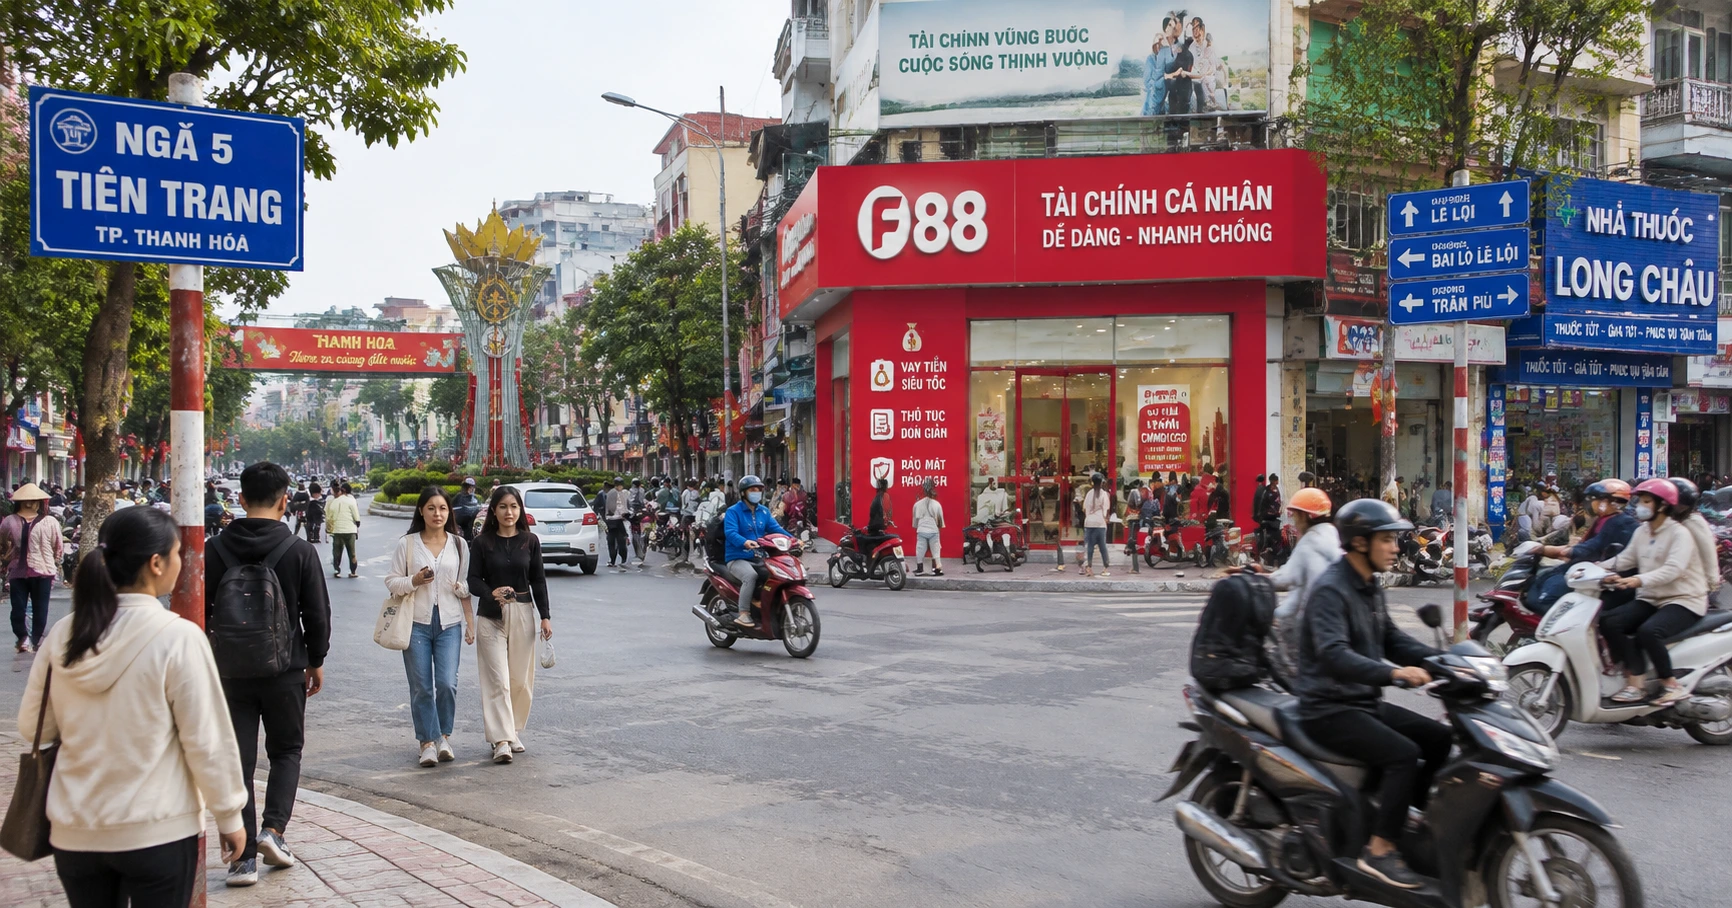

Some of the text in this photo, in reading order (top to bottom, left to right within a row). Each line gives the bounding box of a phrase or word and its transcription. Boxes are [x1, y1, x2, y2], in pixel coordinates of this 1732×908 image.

[998, 53, 1046, 72] THỊNH
[211, 133, 233, 165] 5
[56, 165, 282, 226] TIÊN TRANG
[1041, 186, 1077, 217] TÀI
[1084, 183, 1157, 216] CHÍNH
[1205, 179, 1273, 212] NHÂN
[95, 226, 129, 244] TP.
[134, 229, 201, 249] THANH
[857, 185, 989, 260] F88
[1138, 225, 1202, 245] NHANH
[1554, 255, 1714, 307] LONG CHÂU
[900, 361, 921, 373] VAY
